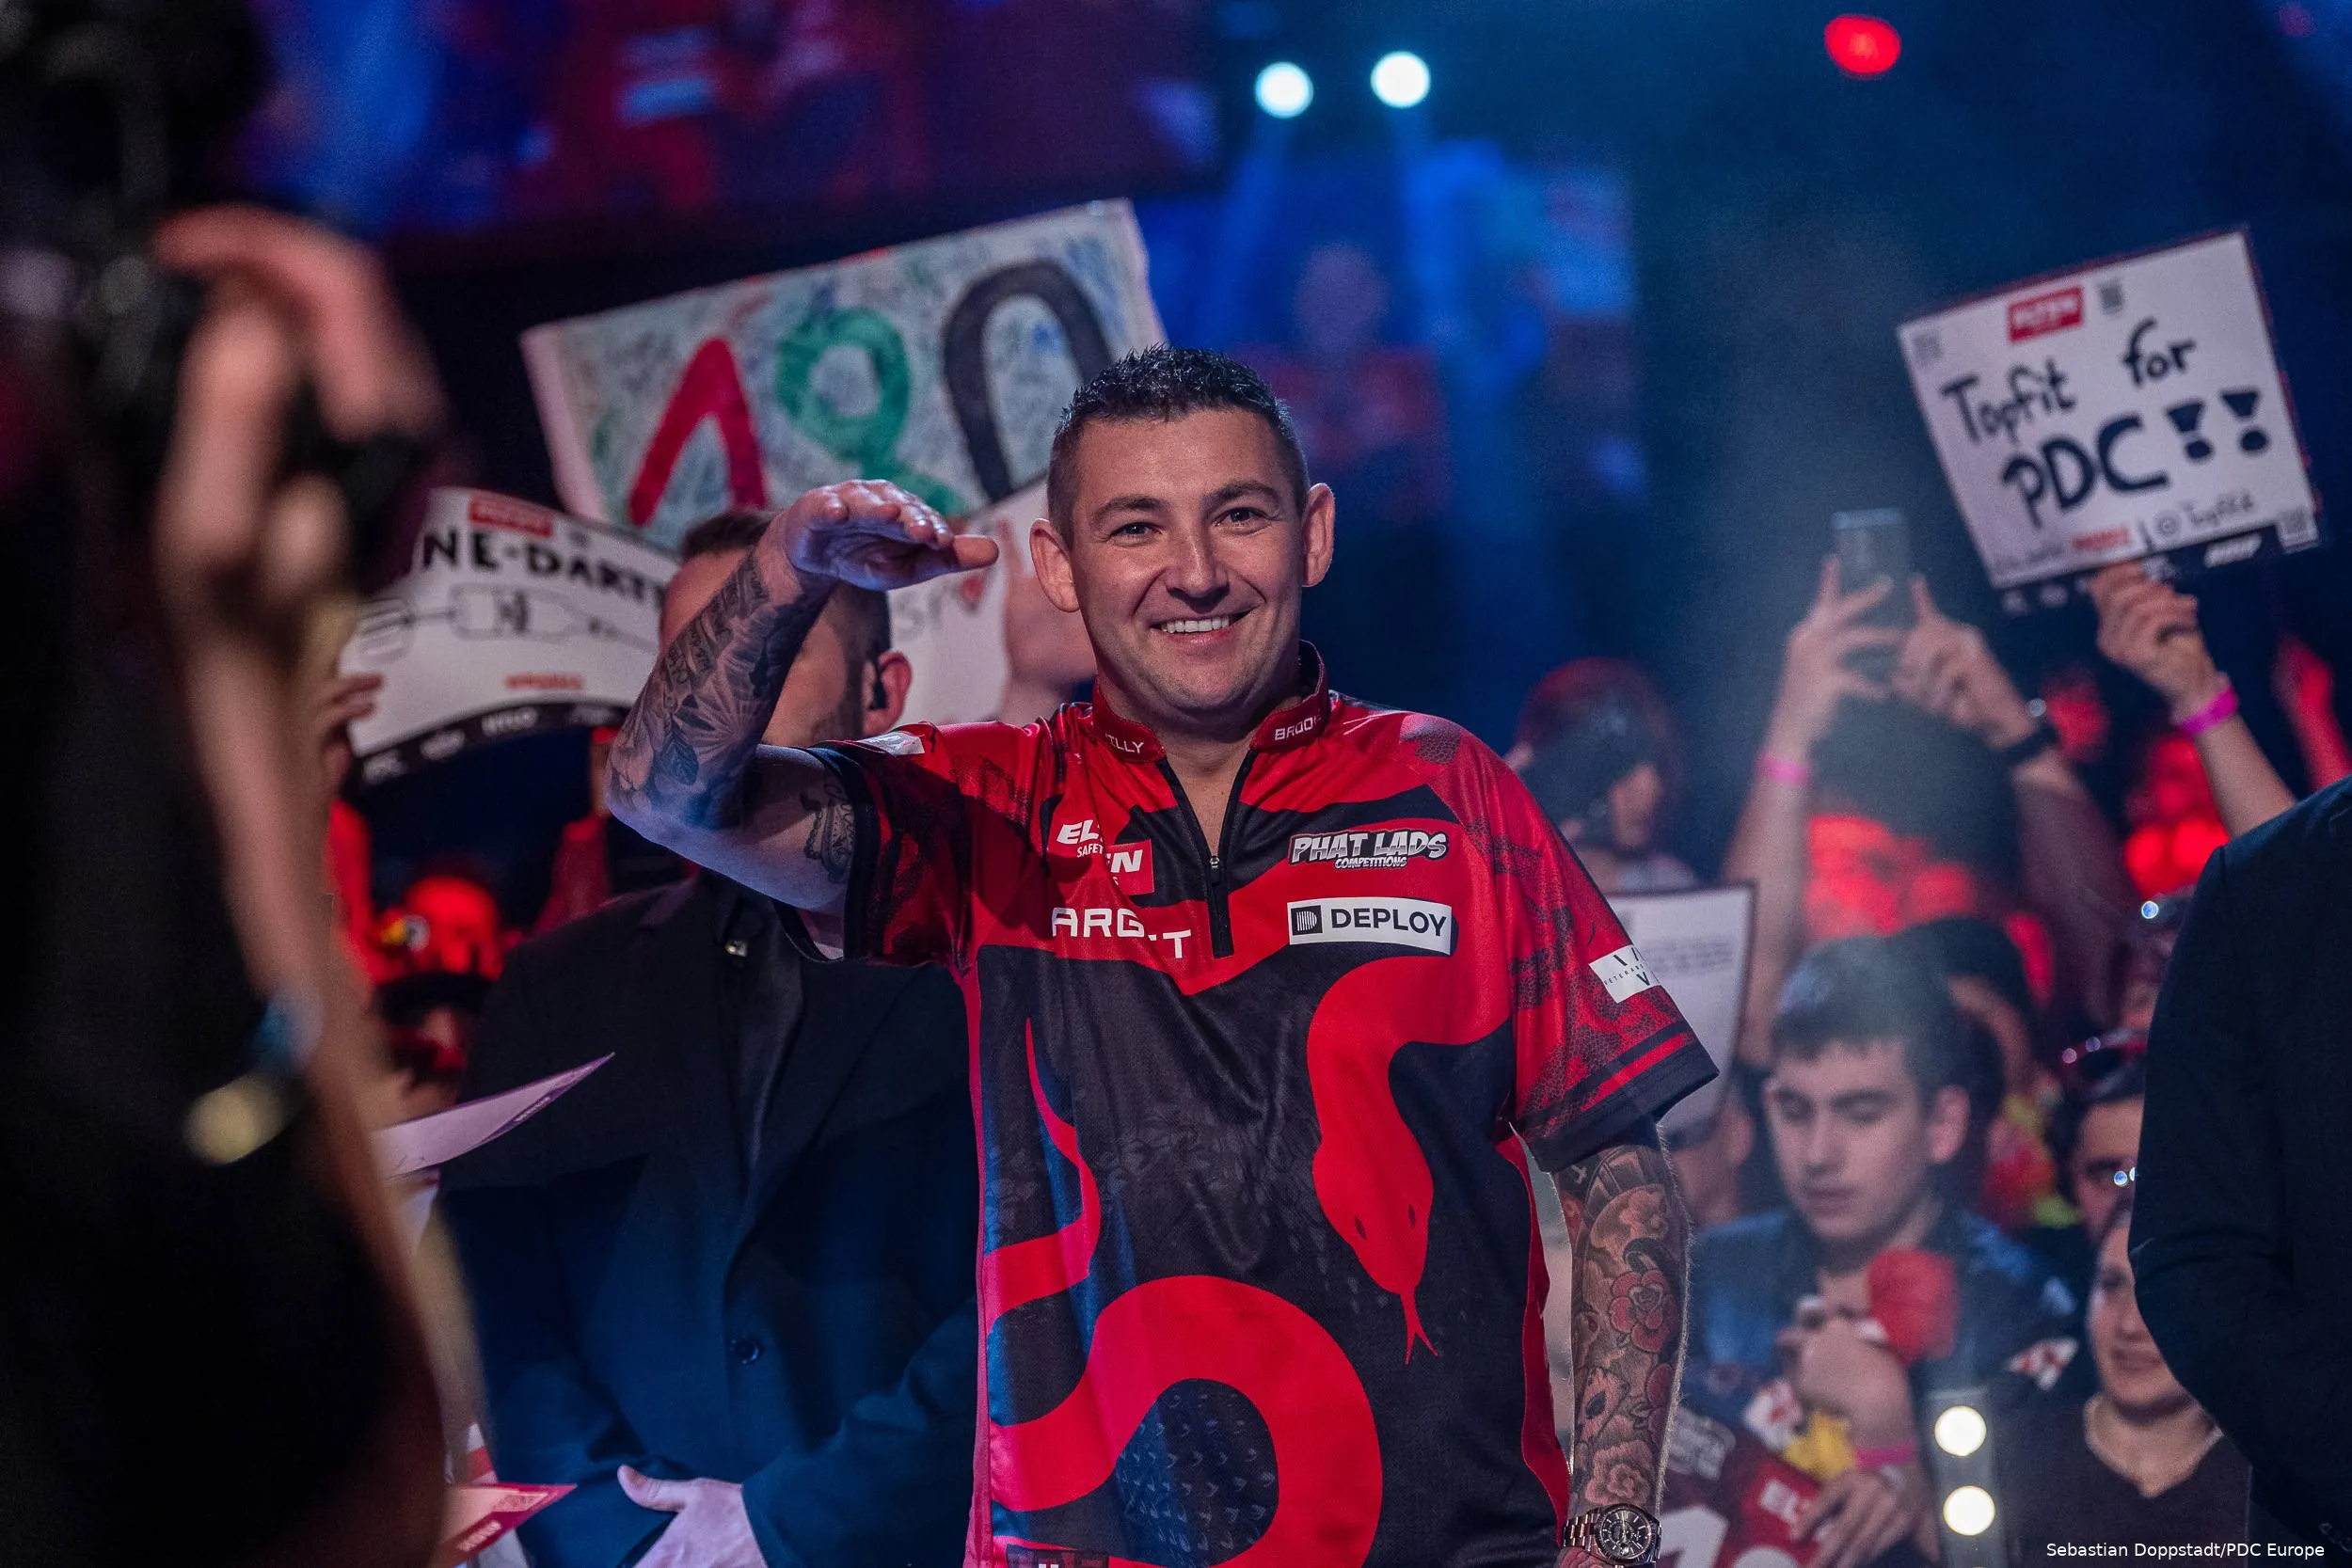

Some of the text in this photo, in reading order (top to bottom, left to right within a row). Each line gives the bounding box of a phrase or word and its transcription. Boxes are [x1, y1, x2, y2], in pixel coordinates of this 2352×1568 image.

[1941, 317, 2198, 446] Topfit for
[1274, 716, 1322, 741] BROO
[1104, 733, 1145, 753] ILLY
[1076, 844, 1104, 859] SAFET
[1292, 831, 1447, 863] PHAT LADS
[1334, 856, 1407, 869] COMPETITIONS
[1051, 907, 1192, 959] ARGT
[1330, 908, 1447, 937] DEPLOY
